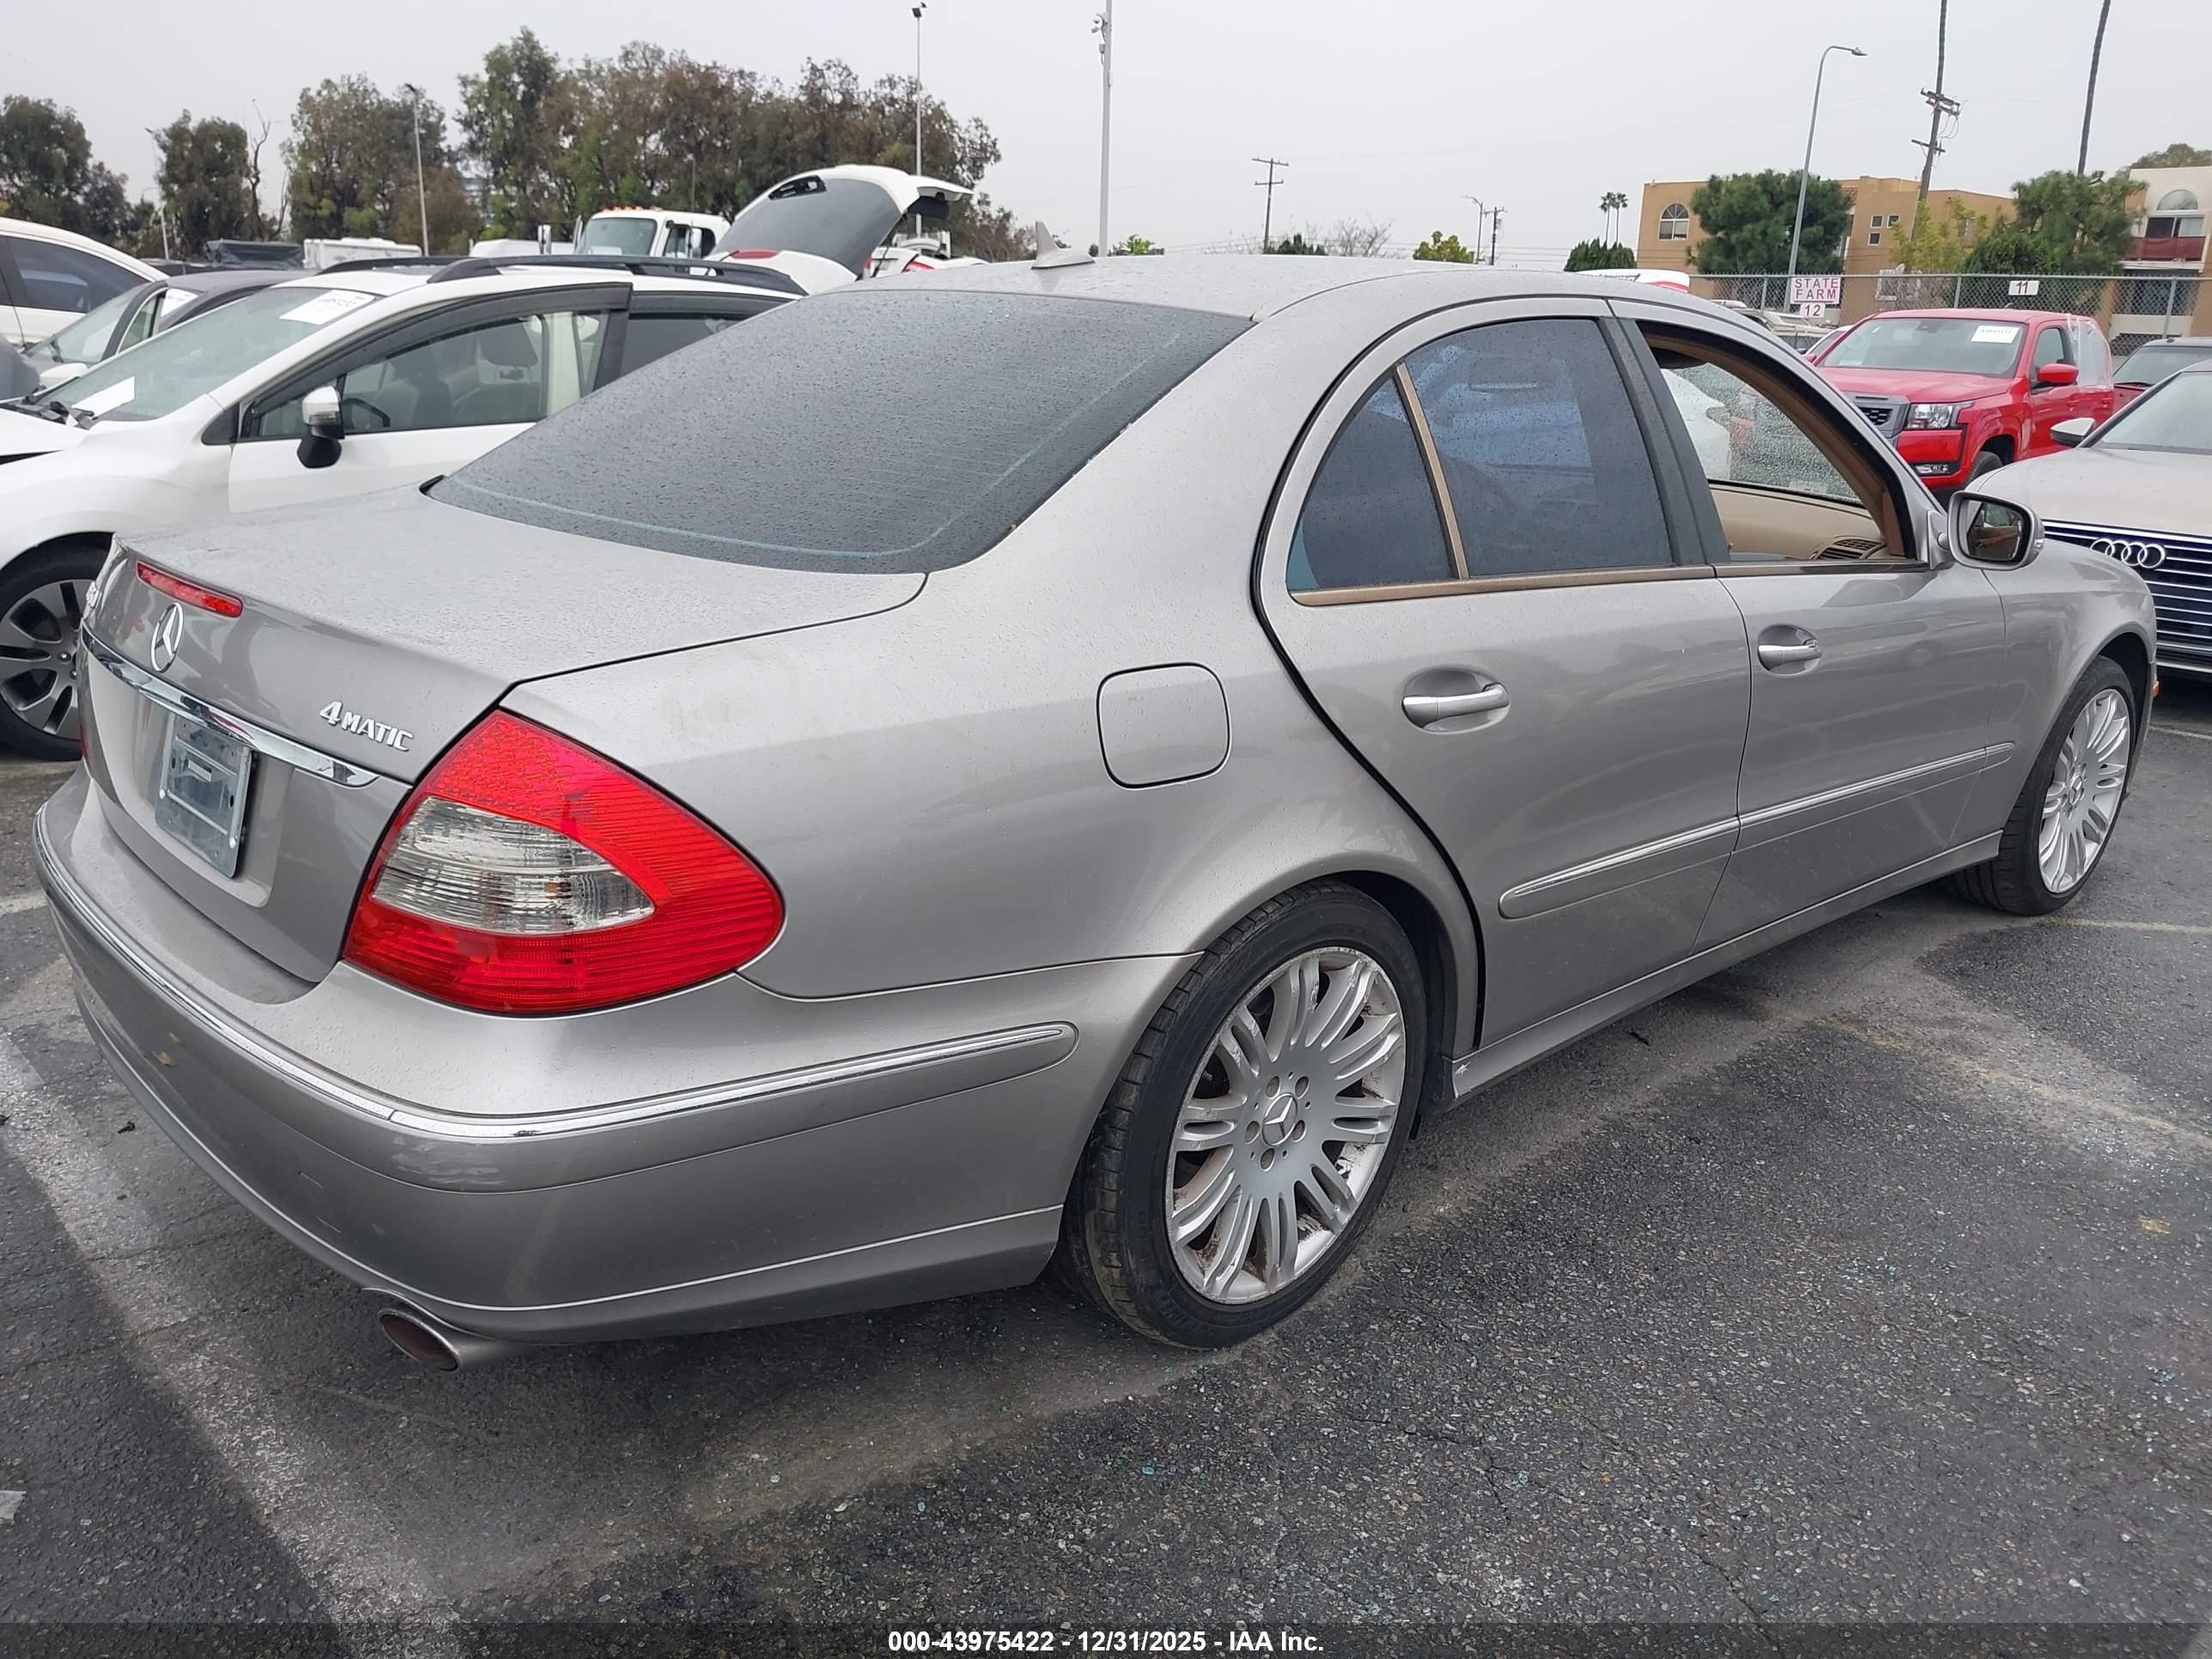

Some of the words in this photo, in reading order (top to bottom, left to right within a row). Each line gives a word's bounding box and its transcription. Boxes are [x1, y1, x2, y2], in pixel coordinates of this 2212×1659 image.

[1795, 277, 1838, 289] STATE
[2015, 281, 2028, 295] 11
[1796, 289, 1837, 300] FARM
[1804, 304, 1821, 317] 12
[319, 701, 414, 752] 4MATIC
